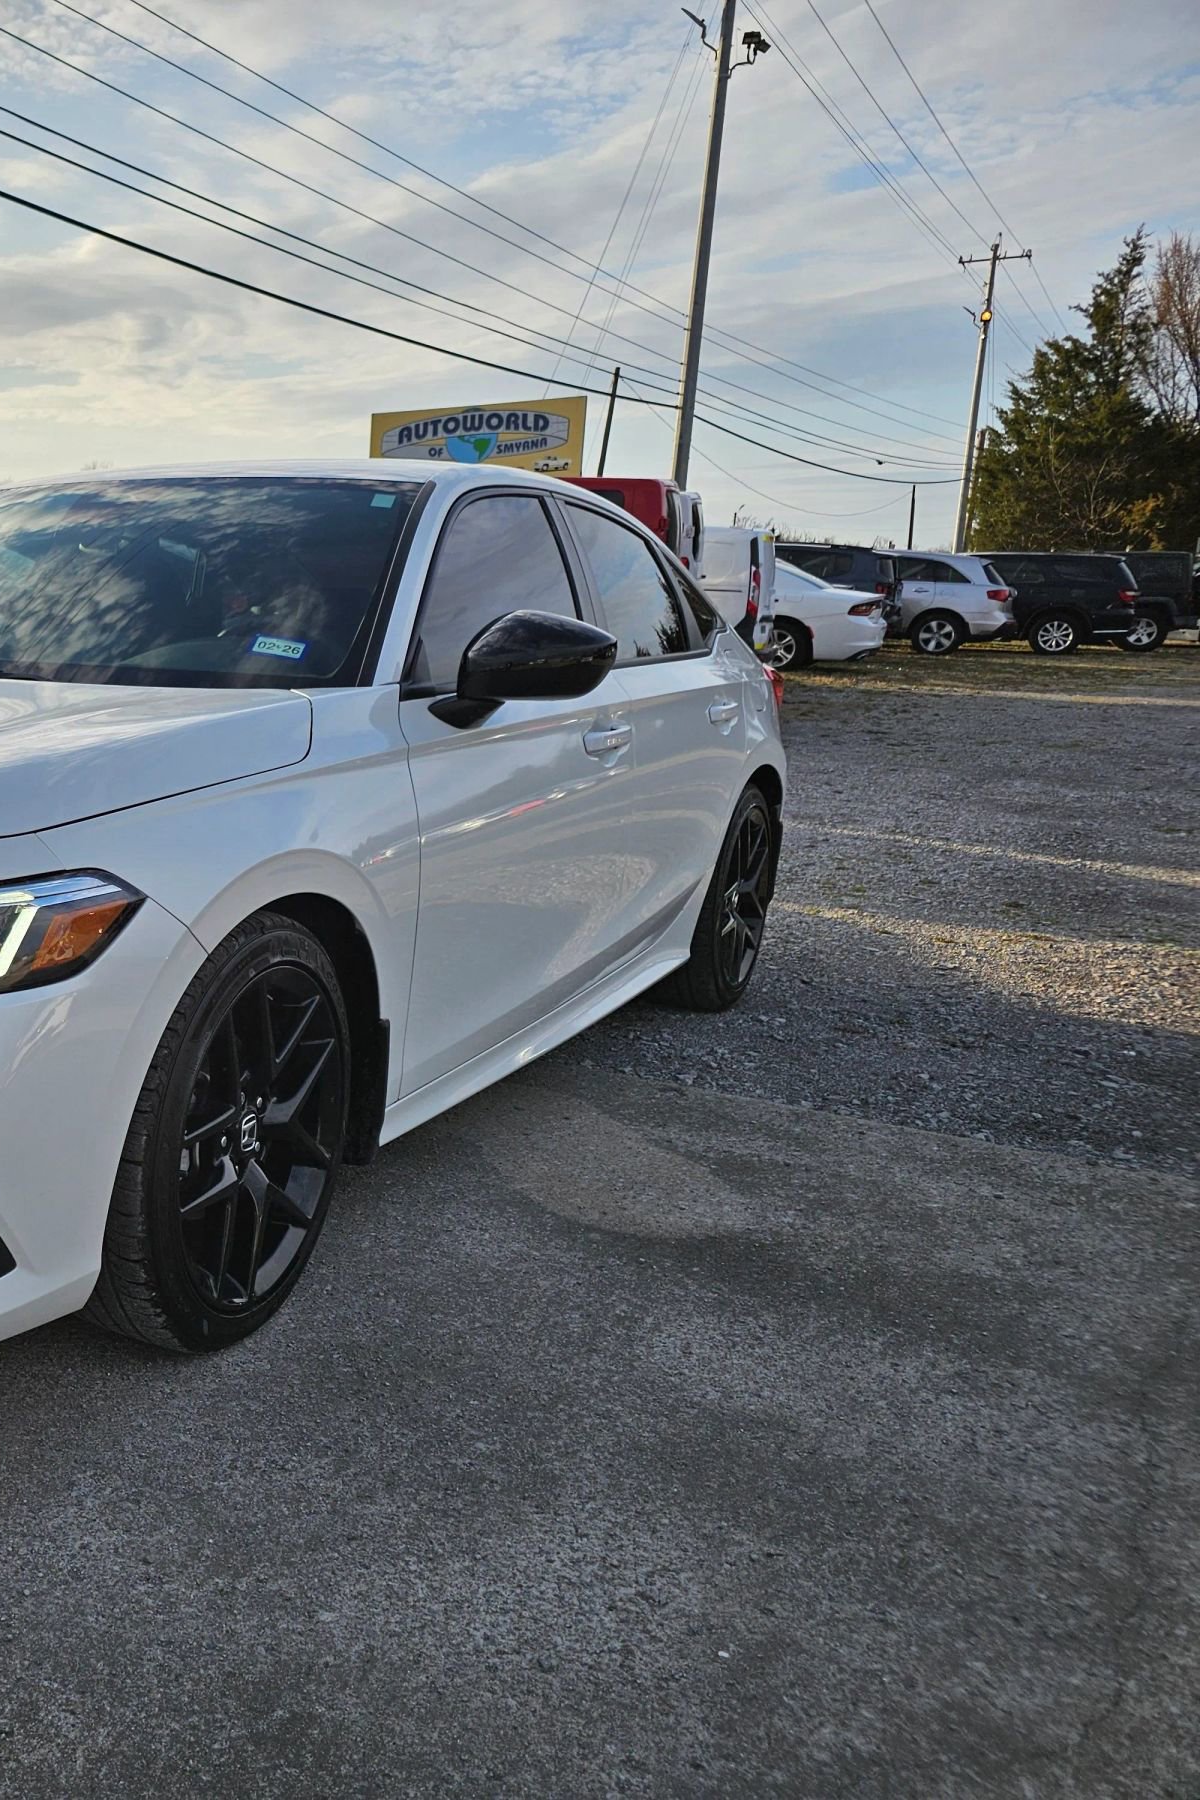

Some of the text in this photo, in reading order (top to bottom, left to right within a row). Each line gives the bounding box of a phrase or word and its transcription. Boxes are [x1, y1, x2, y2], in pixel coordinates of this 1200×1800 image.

[398, 412, 550, 444] AUTOWORLD
[428, 438, 548, 458] OF SMYRNA
